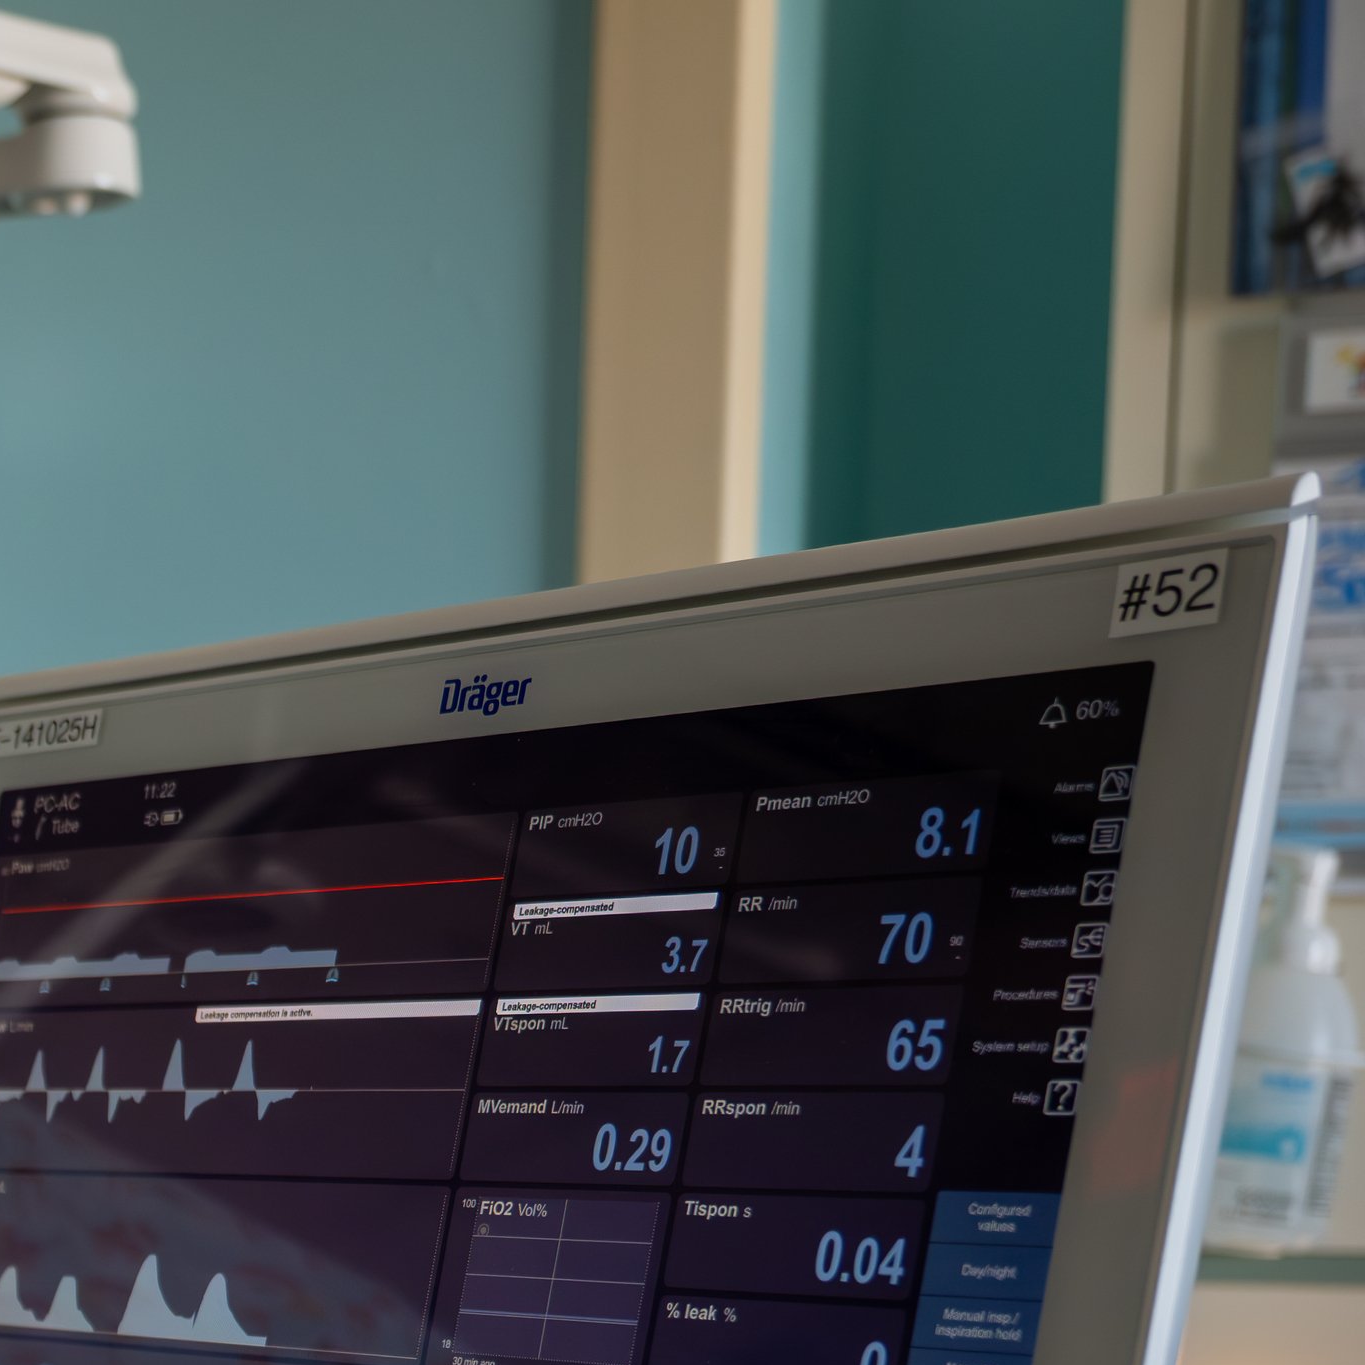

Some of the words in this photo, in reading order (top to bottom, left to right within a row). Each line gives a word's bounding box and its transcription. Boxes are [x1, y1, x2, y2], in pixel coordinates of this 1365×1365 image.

[1118, 563, 1219, 622] #52
[439, 674, 532, 716] Dräger
[1076, 700, 1119, 720] 60%
[144, 782, 177, 799] 11:22
[756, 795, 811, 812] Pmean
[817, 789, 870, 807] cmH2O
[52, 820, 80, 835] Tube
[529, 814, 554, 831] PIP
[558, 811, 603, 829] cmH2O
[915, 806, 981, 859] 8.1
[1052, 833, 1086, 845] Views
[655, 825, 701, 876] 10
[519, 901, 614, 918] Leakage-compensated
[738, 896, 763, 912] RR
[768, 896, 797, 911] /min
[511, 922, 530, 936] VT
[534, 921, 553, 935] mL
[878, 911, 933, 965] 70
[1020, 936, 1067, 949] Sensors
[661, 936, 709, 974] 3.7
[993, 988, 1058, 1001] Procedures
[200, 1010, 228, 1021] Leakage
[230, 1008, 280, 1020] compensation
[502, 999, 596, 1013] Leakage-compensated
[720, 998, 771, 1017] RRtrig
[776, 998, 805, 1013] /min
[494, 1017, 546, 1034] VTspon
[550, 1017, 569, 1031] mL
[886, 1018, 946, 1071] 65
[648, 1035, 691, 1074] 1.7
[477, 1099, 547, 1114] MVemand
[551, 1100, 584, 1114] L/min
[702, 1099, 766, 1118] RRspon
[771, 1100, 800, 1116] /min
[593, 1122, 671, 1172] 0.29
[894, 1124, 925, 1178] 4
[462, 1199, 477, 1209] 100
[480, 1200, 512, 1216] FiO2
[518, 1203, 548, 1217] Vol%
[684, 1200, 738, 1220] Tispon
[743, 1206, 752, 1218] s
[968, 1202, 1032, 1218] Configured
[978, 1221, 1016, 1233] values
[815, 1230, 906, 1285] 0.04
[666, 1302, 679, 1318] %
[684, 1304, 716, 1321] leak
[723, 1307, 737, 1322] %
[442, 1339, 451, 1349] 18
